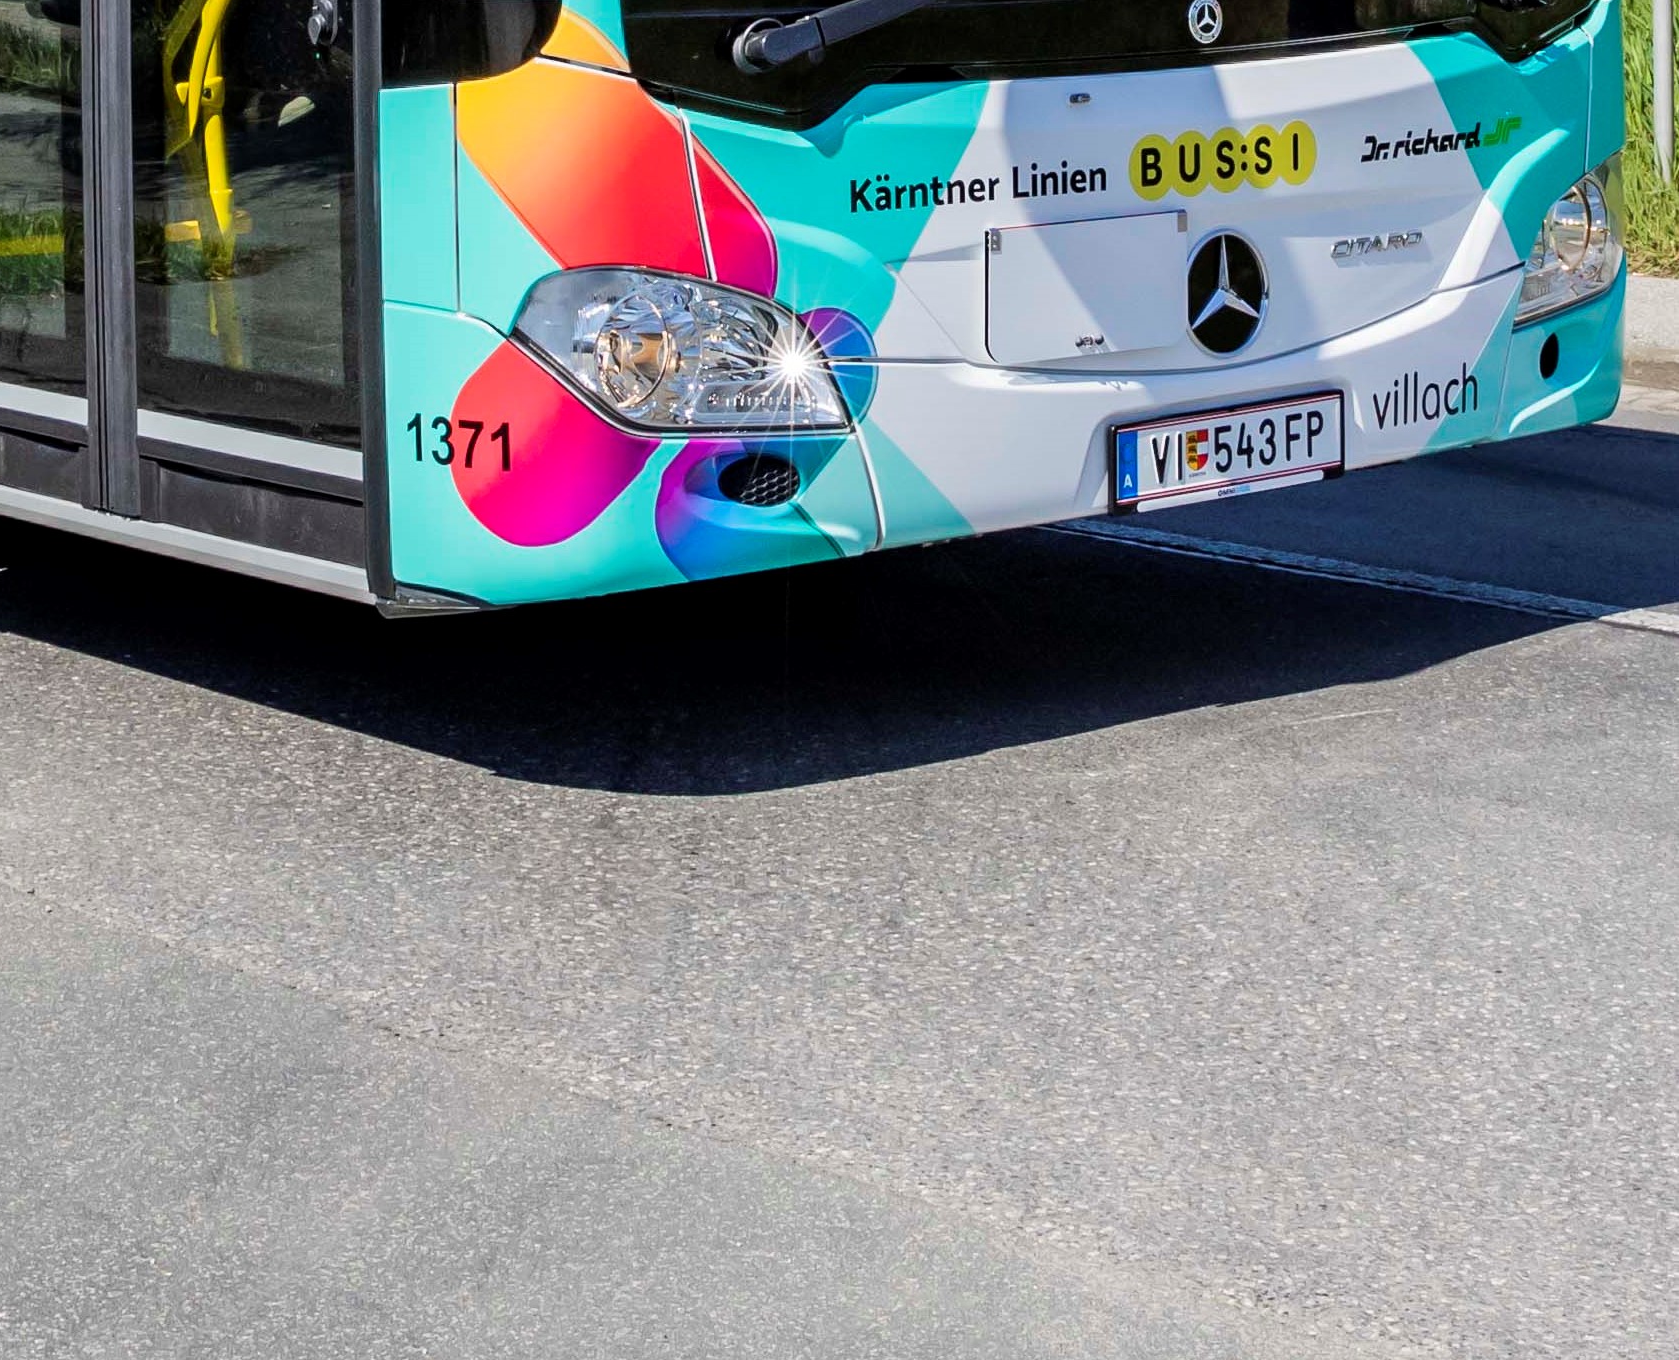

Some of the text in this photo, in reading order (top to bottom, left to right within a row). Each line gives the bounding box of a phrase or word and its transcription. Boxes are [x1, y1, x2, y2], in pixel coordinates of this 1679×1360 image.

[1392, 122, 1481, 159] richard
[849, 160, 1107, 213] Kärntner Linien
[1372, 361, 1479, 430] villach
[407, 412, 511, 472] 1371
[1151, 432, 1183, 484] VI
[1123, 474, 1133, 488] A
